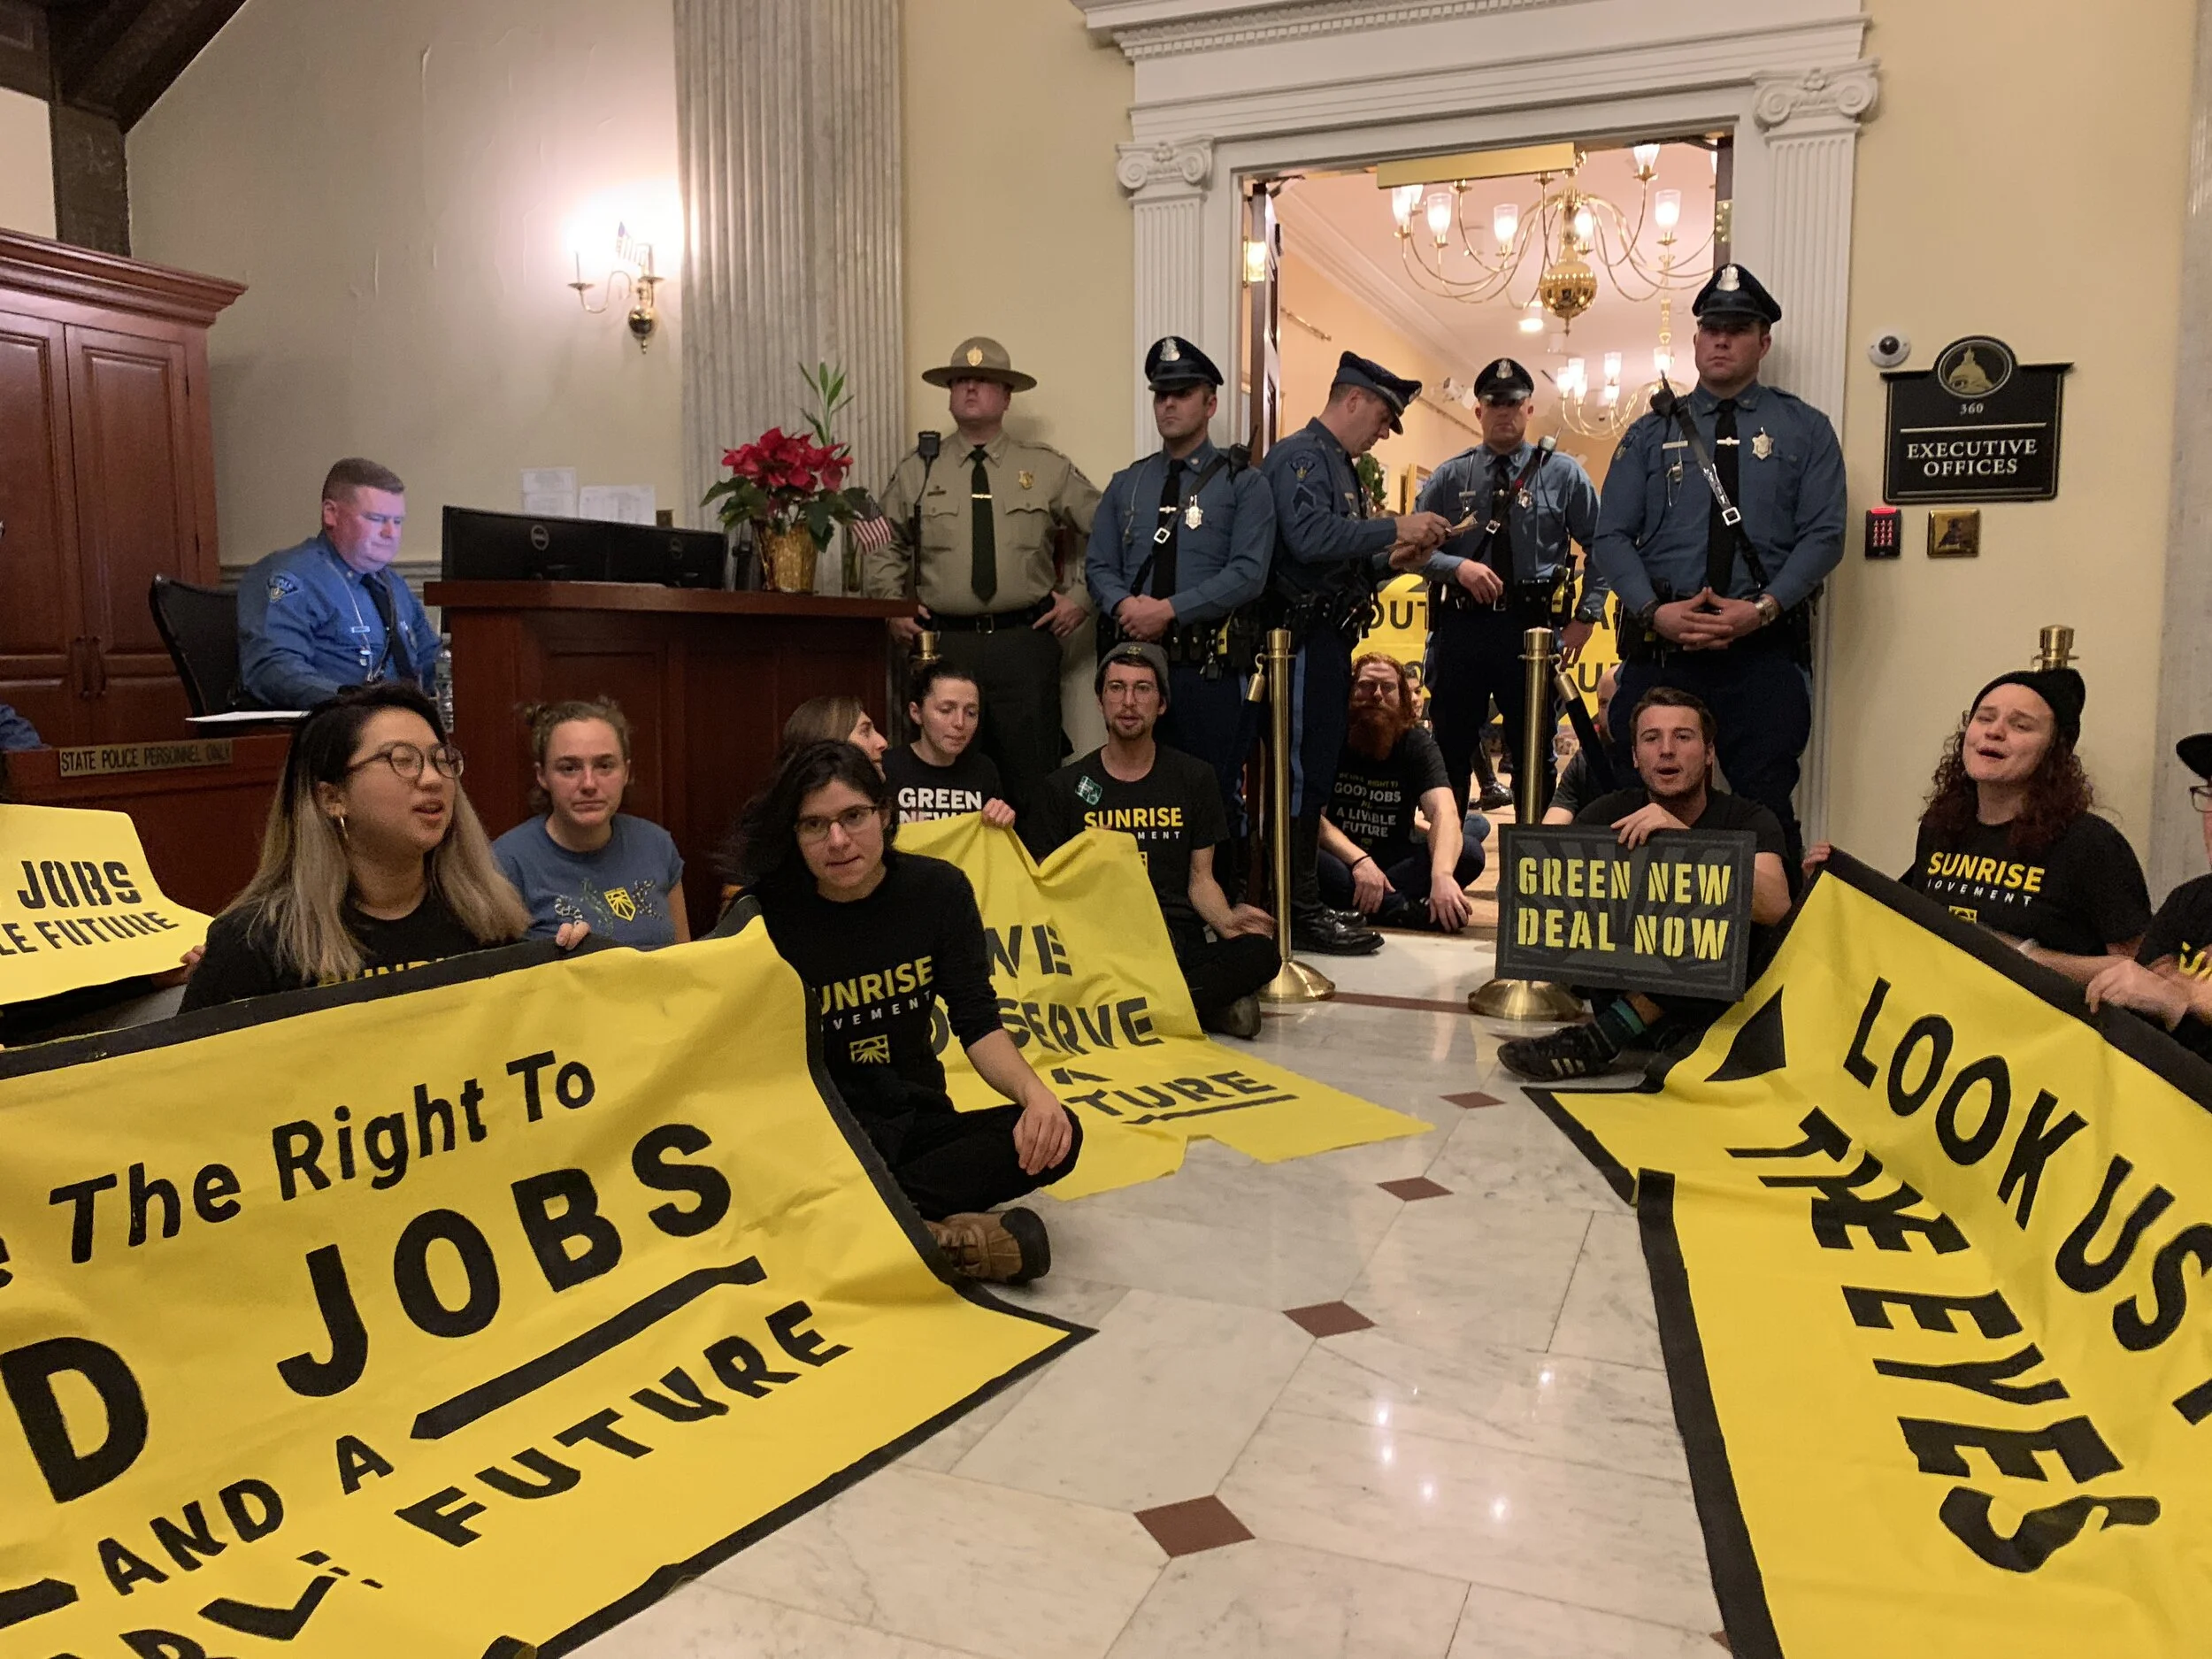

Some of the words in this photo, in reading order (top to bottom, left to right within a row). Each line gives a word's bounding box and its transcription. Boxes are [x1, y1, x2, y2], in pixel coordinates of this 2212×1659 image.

[1907, 439, 2037, 459] EXECUTIVE
[1924, 458, 2018, 477] OFFICES
[61, 751, 96, 772] STATE
[102, 749, 139, 768] POLICE
[898, 787, 982, 810] GREEN
[1334, 782, 1367, 796] GOOD
[1336, 807, 1344, 818] A
[1084, 807, 1184, 829] SUNRISE
[1342, 821, 1388, 837] FUTURE
[17, 860, 142, 910] JOBS
[1518, 856, 1631, 900] GREEN
[1648, 862, 1732, 906] NEW
[1927, 851, 2046, 893] SUNRISE
[34, 911, 180, 949] FUTURE
[1517, 907, 1616, 952] DEAL
[1634, 914, 1730, 961] NOW
[820, 955, 934, 1015] UNRISE
[820, 989, 931, 1033] VEMENT
[930, 996, 1164, 1056] SERVE
[1064, 1070, 1278, 1117] TURE
[49, 1162, 242, 1265] The
[272, 1080, 488, 1202] Right
[506, 1049, 596, 1123] To
[1843, 976, 2089, 1231] LOOK
[2055, 1154, 2212, 1352] US
[276, 1122, 733, 1398] JOBS
[394, 1300, 854, 1548] FUTURE
[1840, 1283, 2162, 1573] EYES
[96, 1478, 285, 1595] AND
[335, 1434, 396, 1496] A
